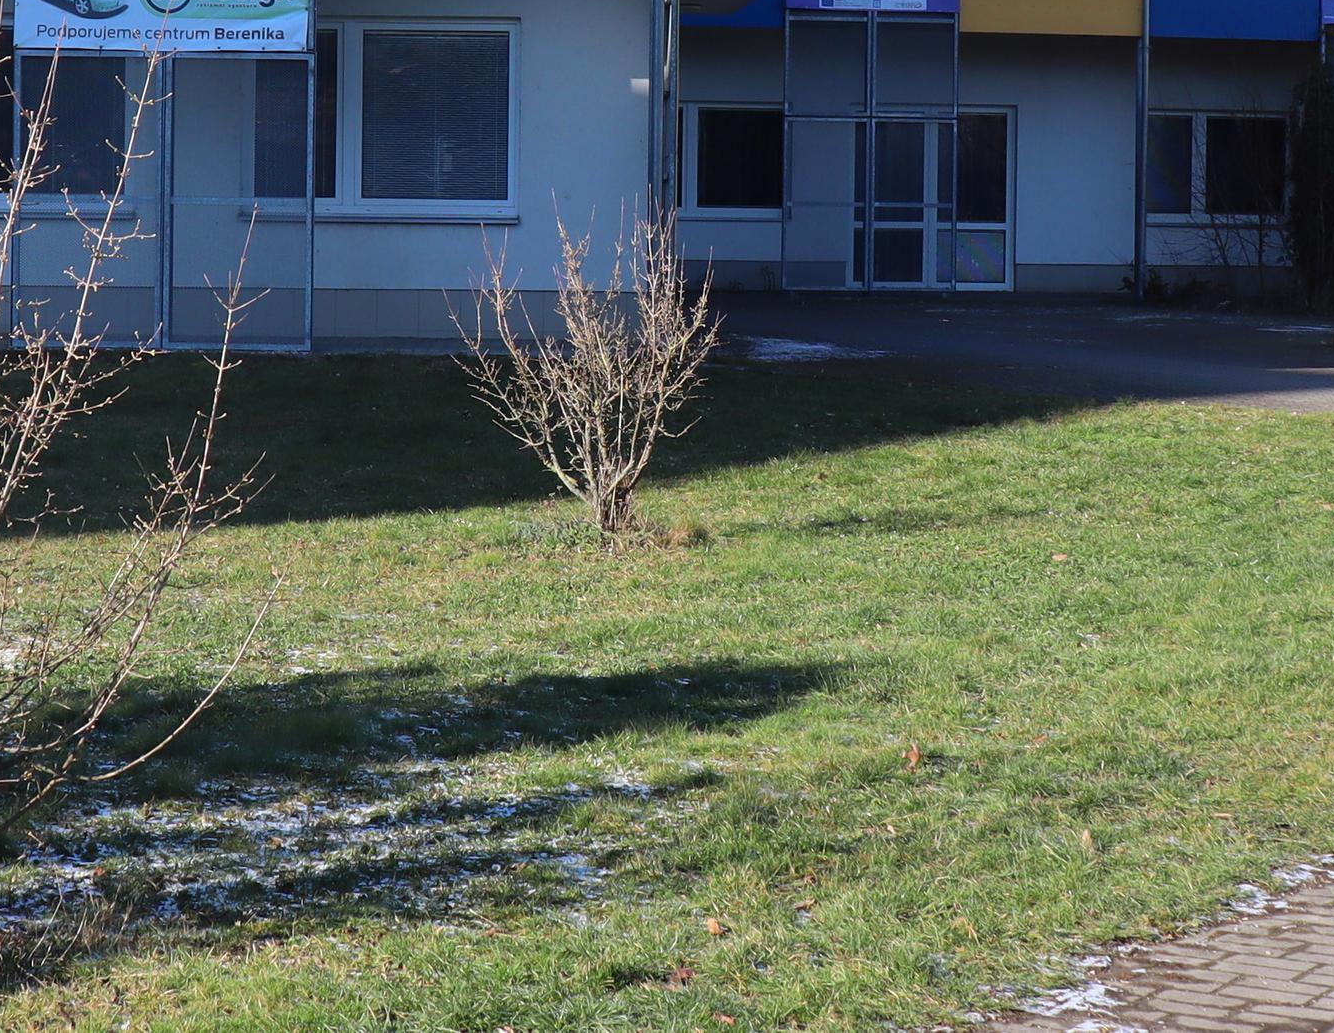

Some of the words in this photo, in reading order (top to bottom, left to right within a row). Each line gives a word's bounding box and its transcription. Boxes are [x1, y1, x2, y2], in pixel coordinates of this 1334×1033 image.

[37, 24, 140, 41] Podporujeme
[145, 26, 209, 40] centrum
[215, 27, 284, 40] Berenika
